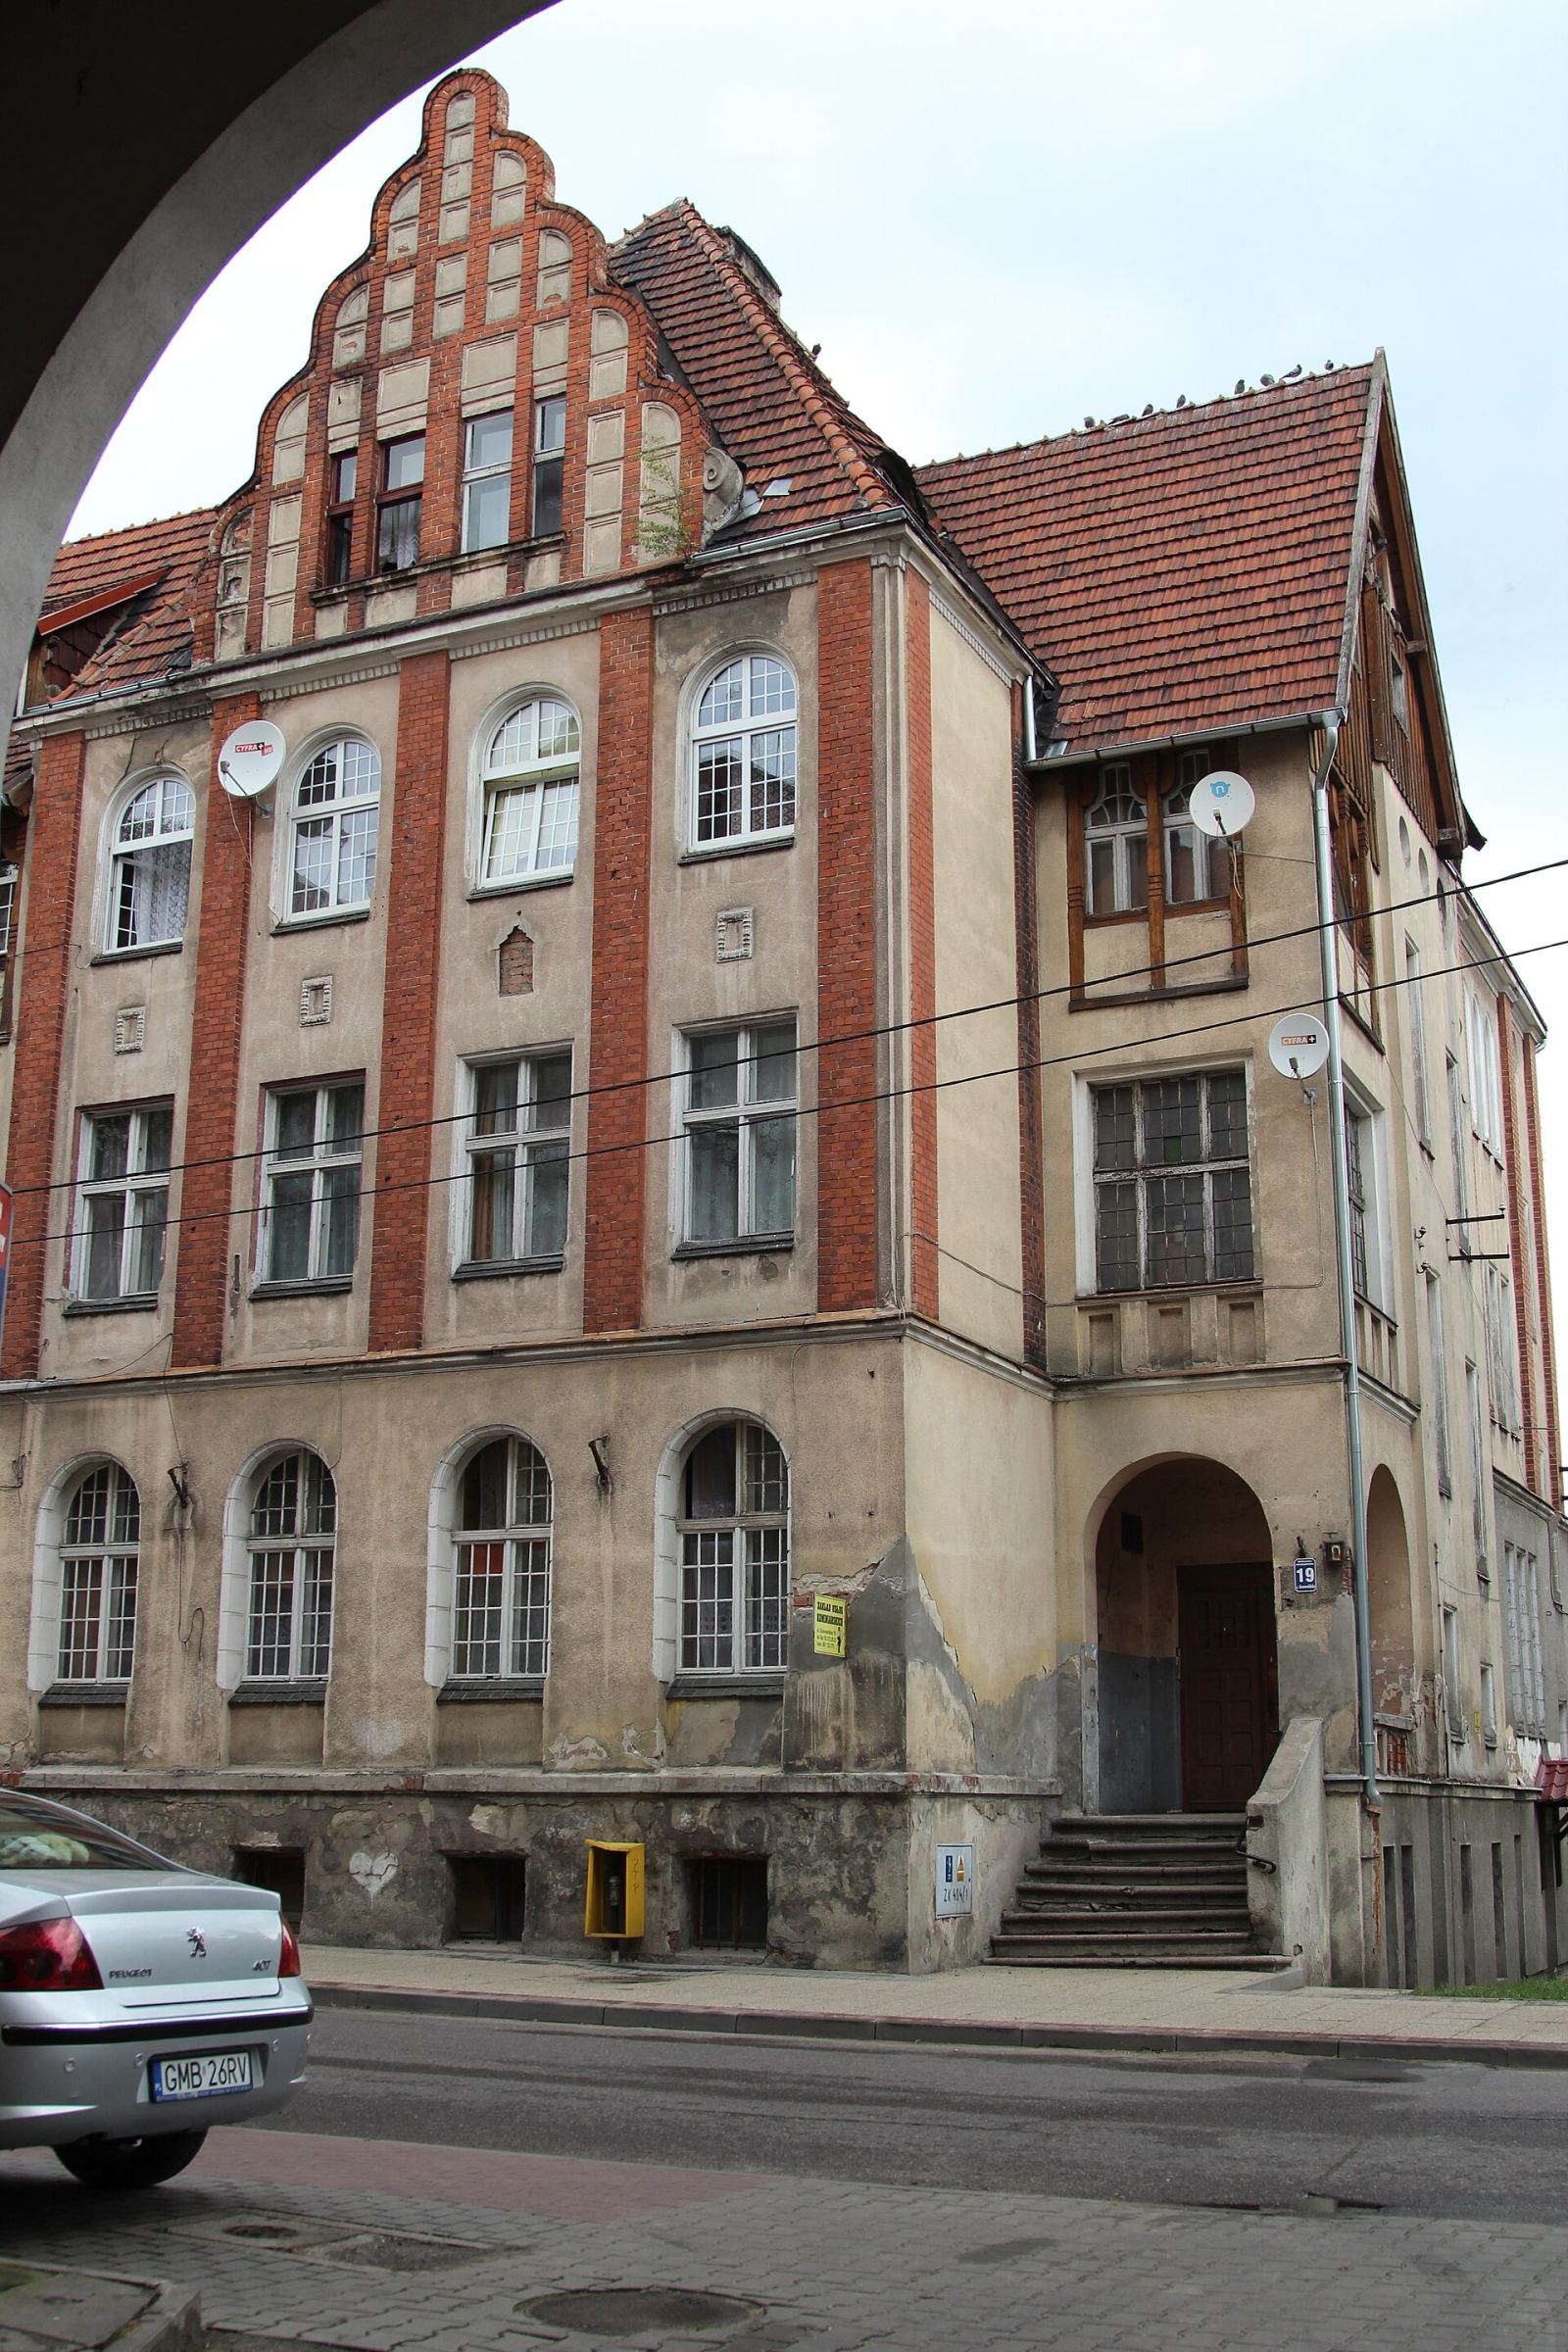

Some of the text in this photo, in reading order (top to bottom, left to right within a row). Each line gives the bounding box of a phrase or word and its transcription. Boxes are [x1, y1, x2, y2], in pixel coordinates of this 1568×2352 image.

[1296, 1567, 1314, 1583] 19
[252, 1959, 270, 1972] 407
[109, 1968, 153, 1979] PEUGEOT
[165, 2061, 203, 2091] GMB
[207, 2056, 247, 2086] 26RV
